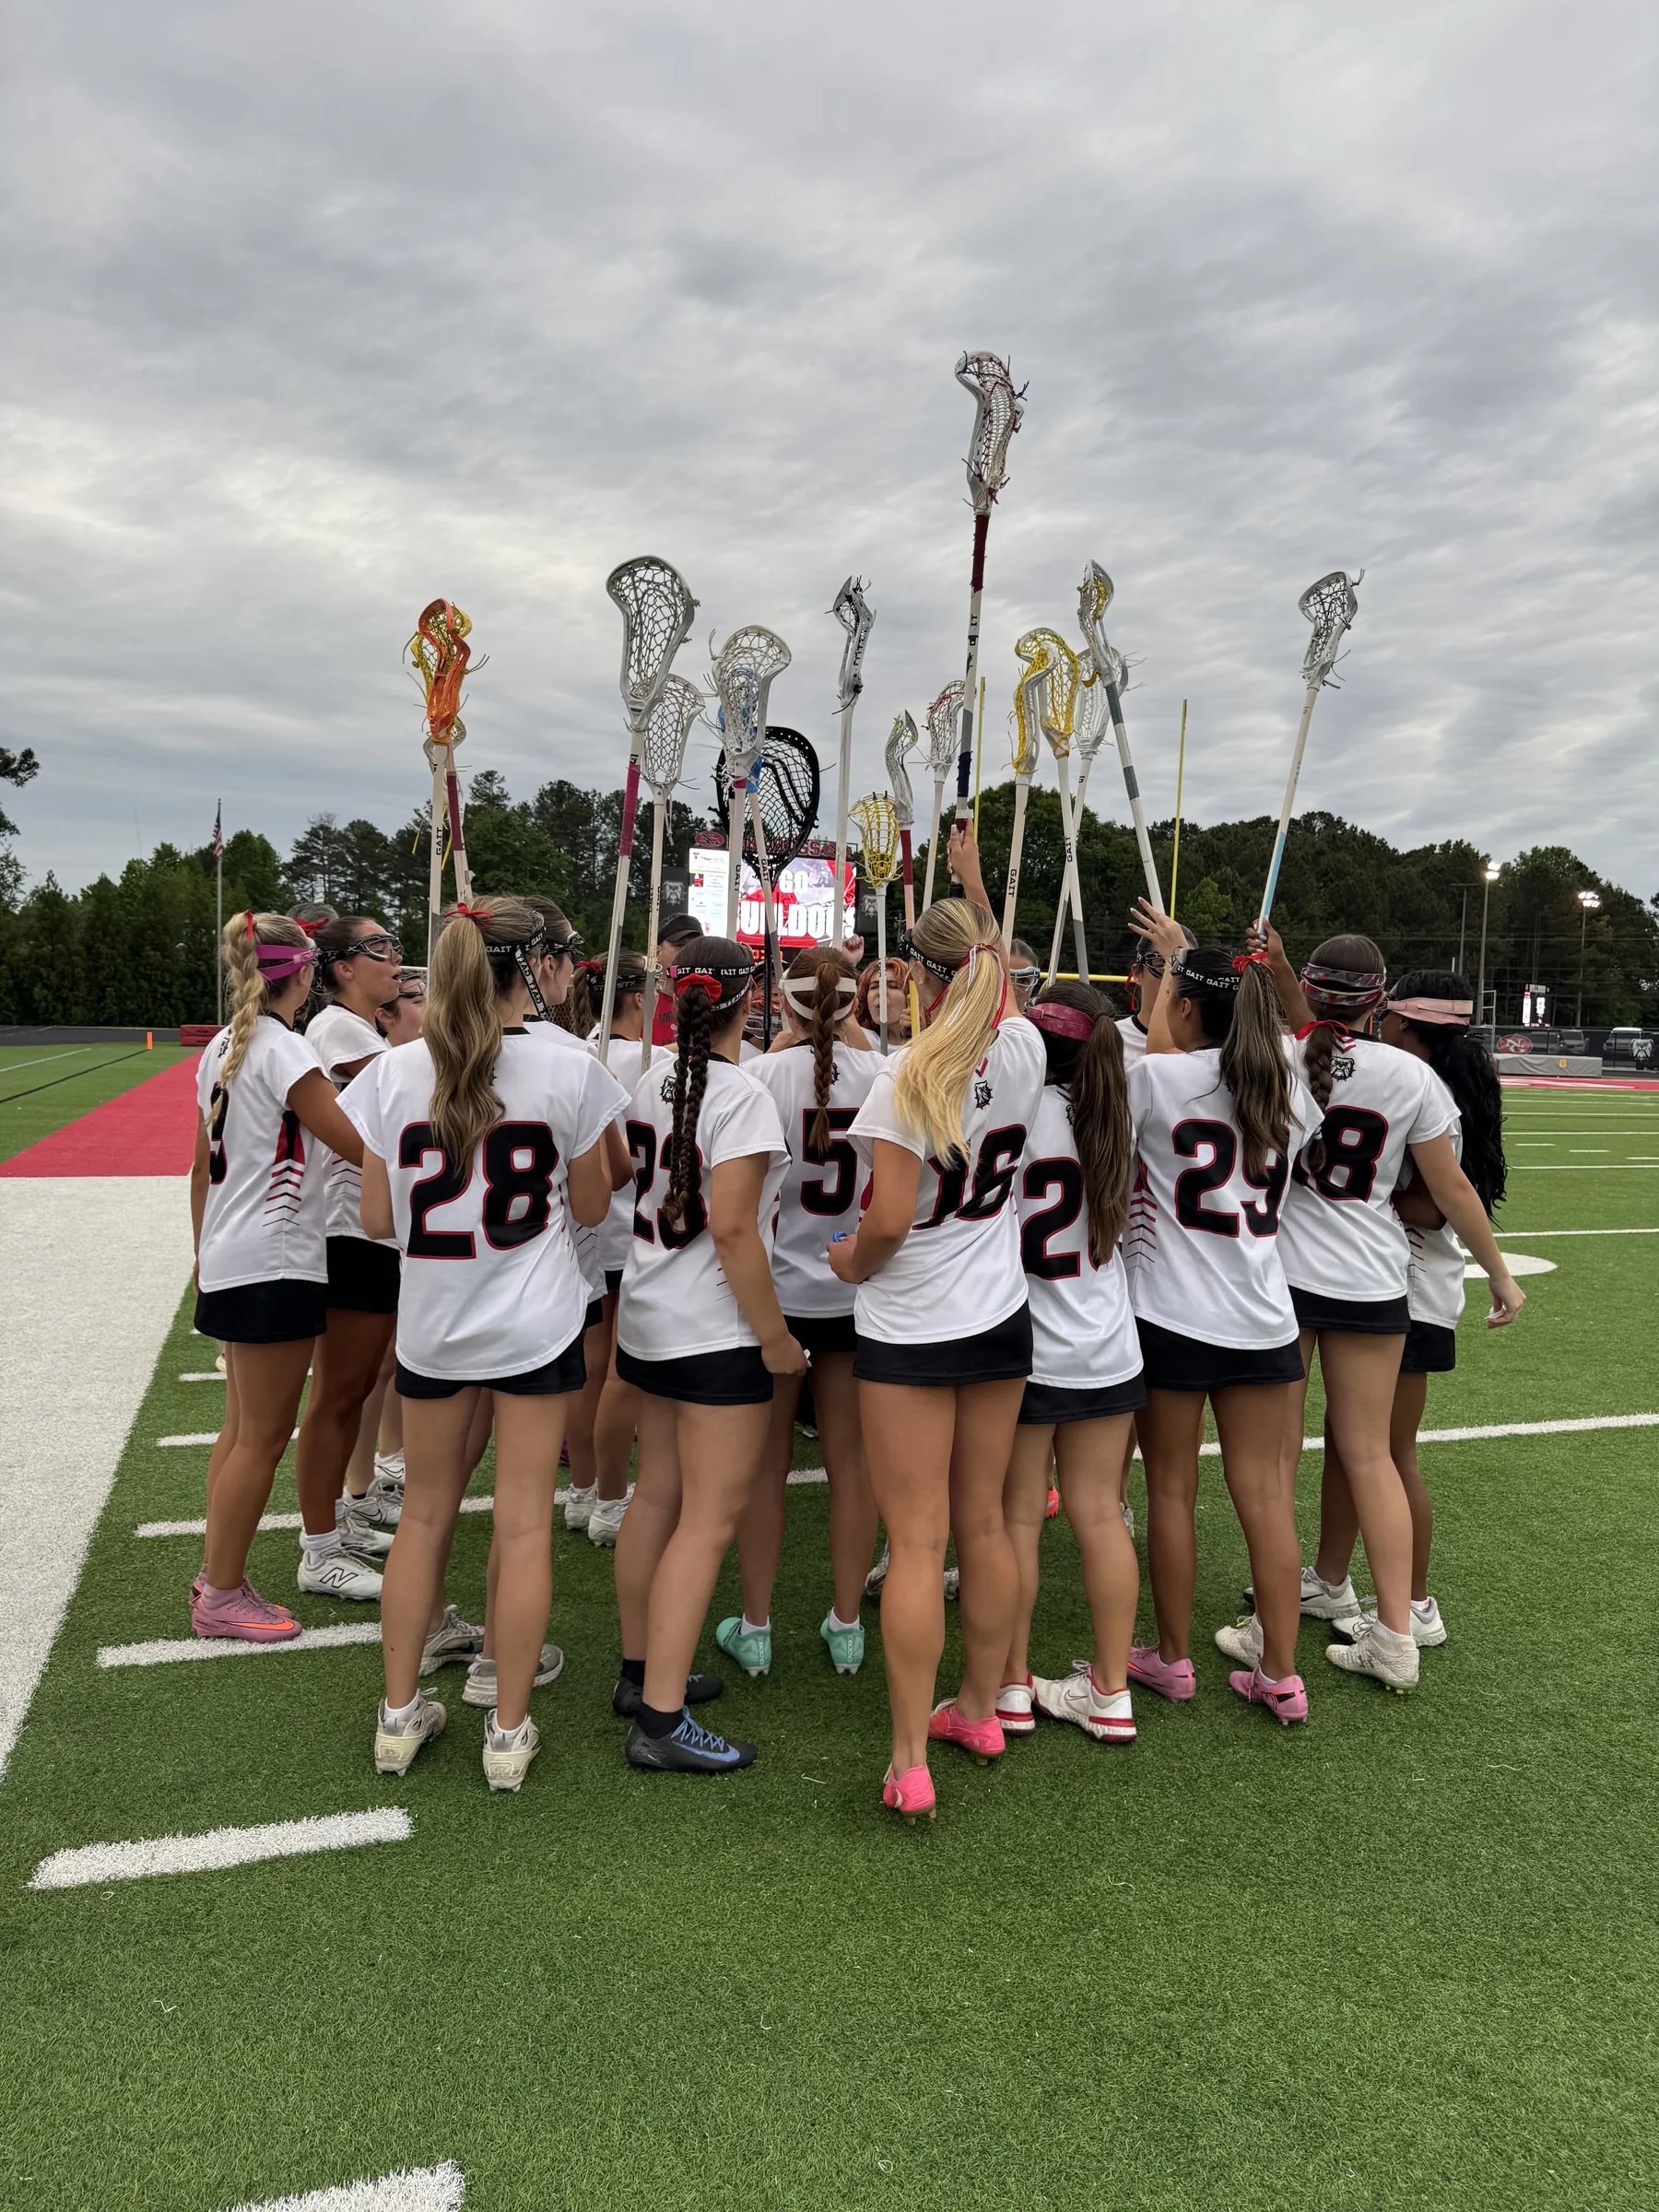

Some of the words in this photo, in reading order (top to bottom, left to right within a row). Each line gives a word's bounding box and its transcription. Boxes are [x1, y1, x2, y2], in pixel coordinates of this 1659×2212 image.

[435, 827, 443, 855] GAIT
[1065, 835, 1074, 863] GAIT
[734, 864, 742, 892] GAIT
[760, 857, 770, 882] GAIT
[779, 870, 808, 894] GO
[1007, 868, 1018, 898] GAIT
[736, 900, 856, 940] ULDOS
[486, 945, 512, 954] GAIT
[910, 947, 924, 962] GAIT
[926, 959, 947, 973] GAIT
[1185, 970, 1205, 982] GAIT
[1206, 978, 1230, 989] GAIT
[800, 1108, 860, 1216] 5
[398, 1120, 559, 1260] 28
[626, 1119, 708, 1251] 23
[912, 1123, 1028, 1232] 16
[1171, 1118, 1290, 1238] 29
[319, 1566, 359, 1589] N
